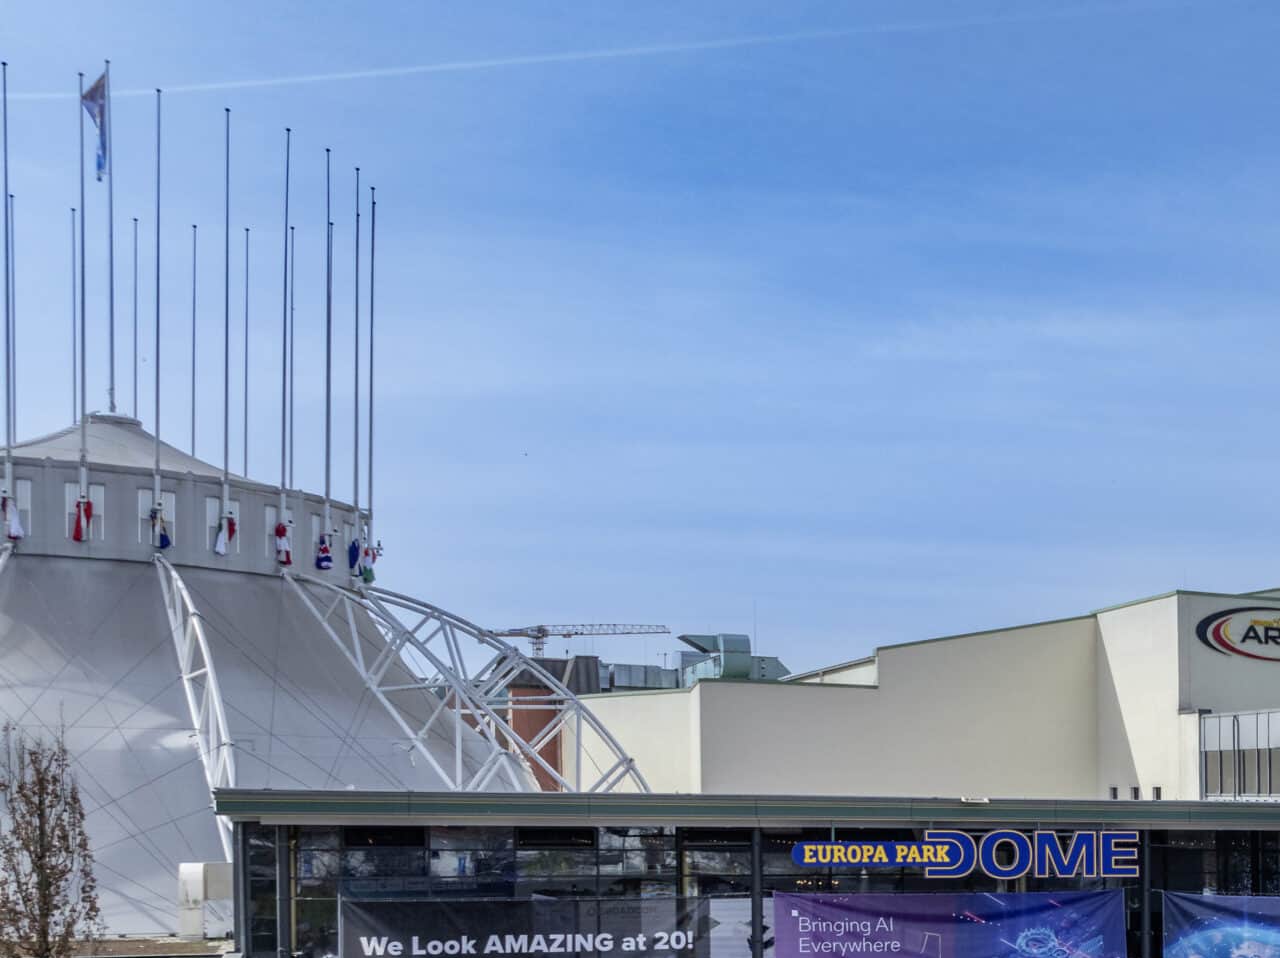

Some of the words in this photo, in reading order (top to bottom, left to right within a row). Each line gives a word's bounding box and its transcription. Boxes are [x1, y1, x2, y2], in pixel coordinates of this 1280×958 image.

[803, 845, 889, 863] EUROPA
[895, 844, 950, 863] PARK
[924, 829, 1140, 880] DOME
[799, 917, 871, 936] Bringing
[875, 917, 893, 932] AI
[360, 936, 404, 956] We
[411, 935, 477, 955] Look
[484, 933, 614, 954] AMAZING
[621, 934, 647, 951] at
[653, 931, 693, 950] 20!
[799, 937, 901, 957] Everywhere
